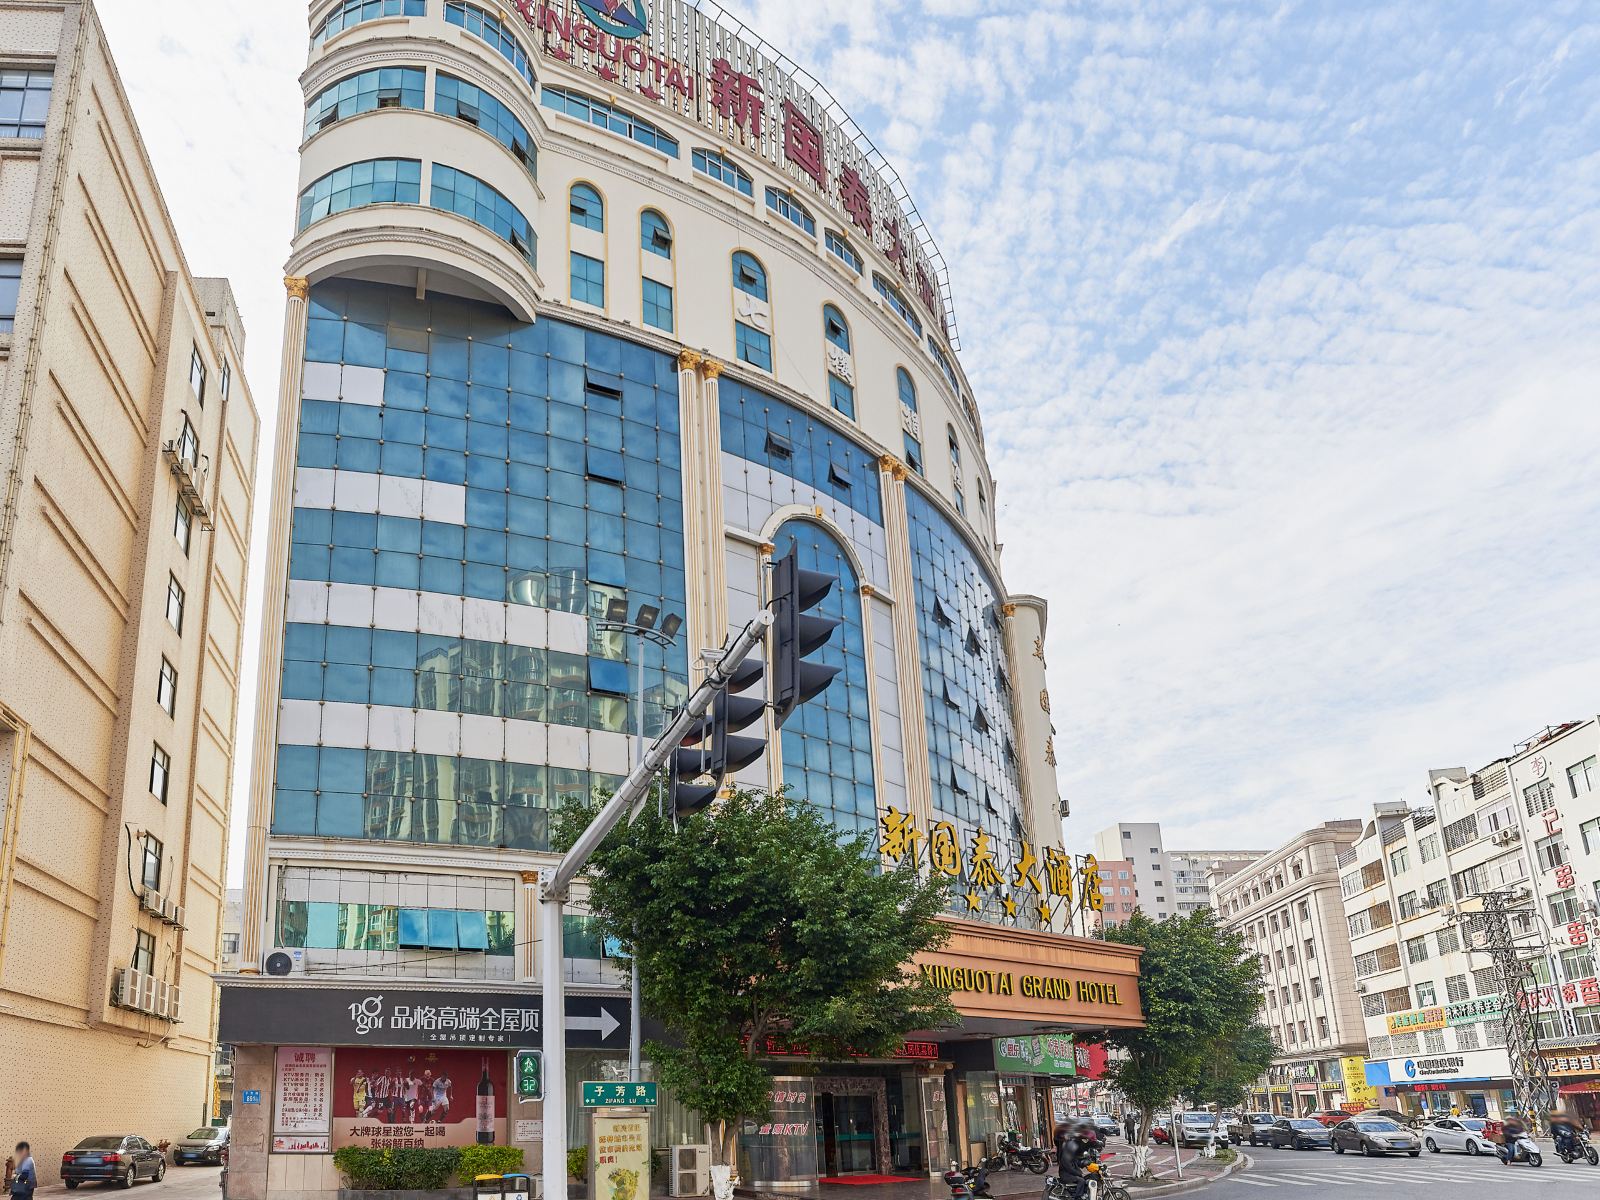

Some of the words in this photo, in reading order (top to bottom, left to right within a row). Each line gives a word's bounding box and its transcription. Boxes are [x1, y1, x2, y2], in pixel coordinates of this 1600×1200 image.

[515, 0, 694, 100] XINGUOTAI
[879, 806, 1105, 912] 新国泰大酒店
[1022, 975, 1072, 1001] GRAND
[1078, 980, 1124, 1005] HOTEL
[391, 1006, 540, 1032] 品格高端全屋顶
[523, 1080, 535, 1091] 32
[594, 1085, 646, 1097] 子芳路
[350, 1126, 446, 1137] 大牌球星邀您一起喝
[371, 1138, 425, 1149] 张裕解百纳
